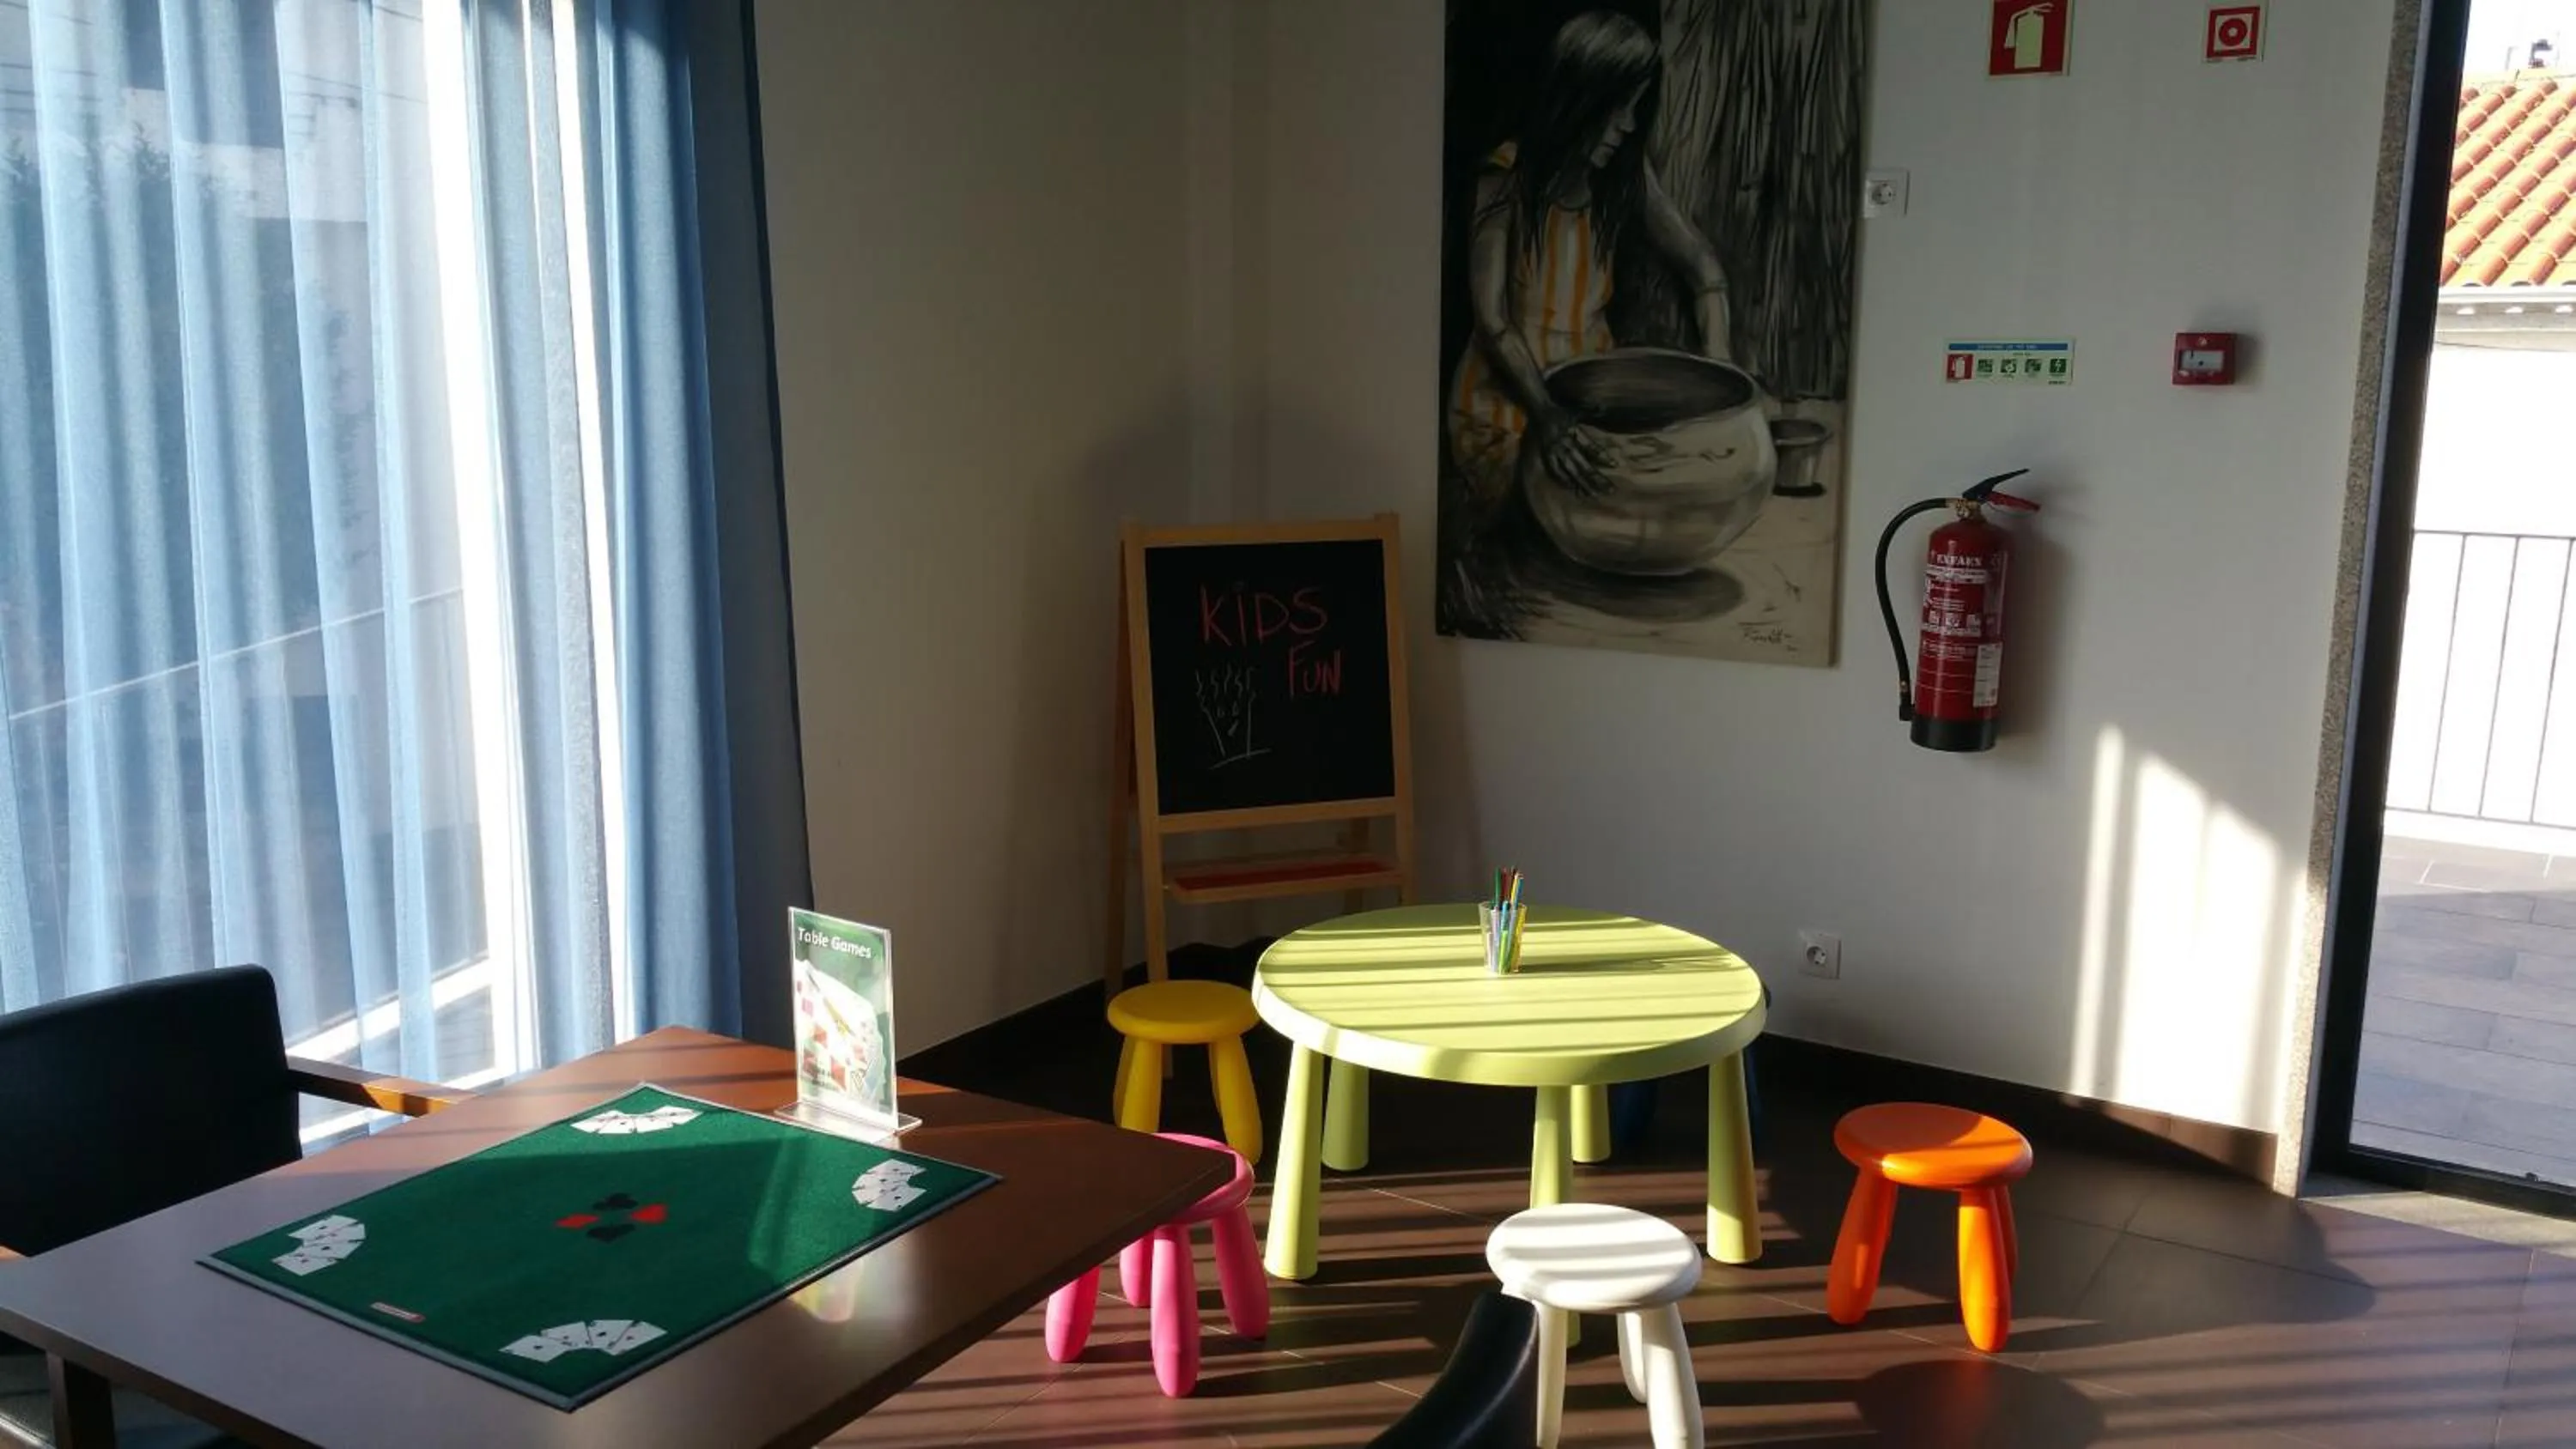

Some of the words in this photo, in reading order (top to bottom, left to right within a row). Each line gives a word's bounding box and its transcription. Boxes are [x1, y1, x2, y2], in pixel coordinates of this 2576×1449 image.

[1288, 640, 1342, 696] FUN
[797, 926, 829, 949] Table
[830, 936, 872, 959] Games
